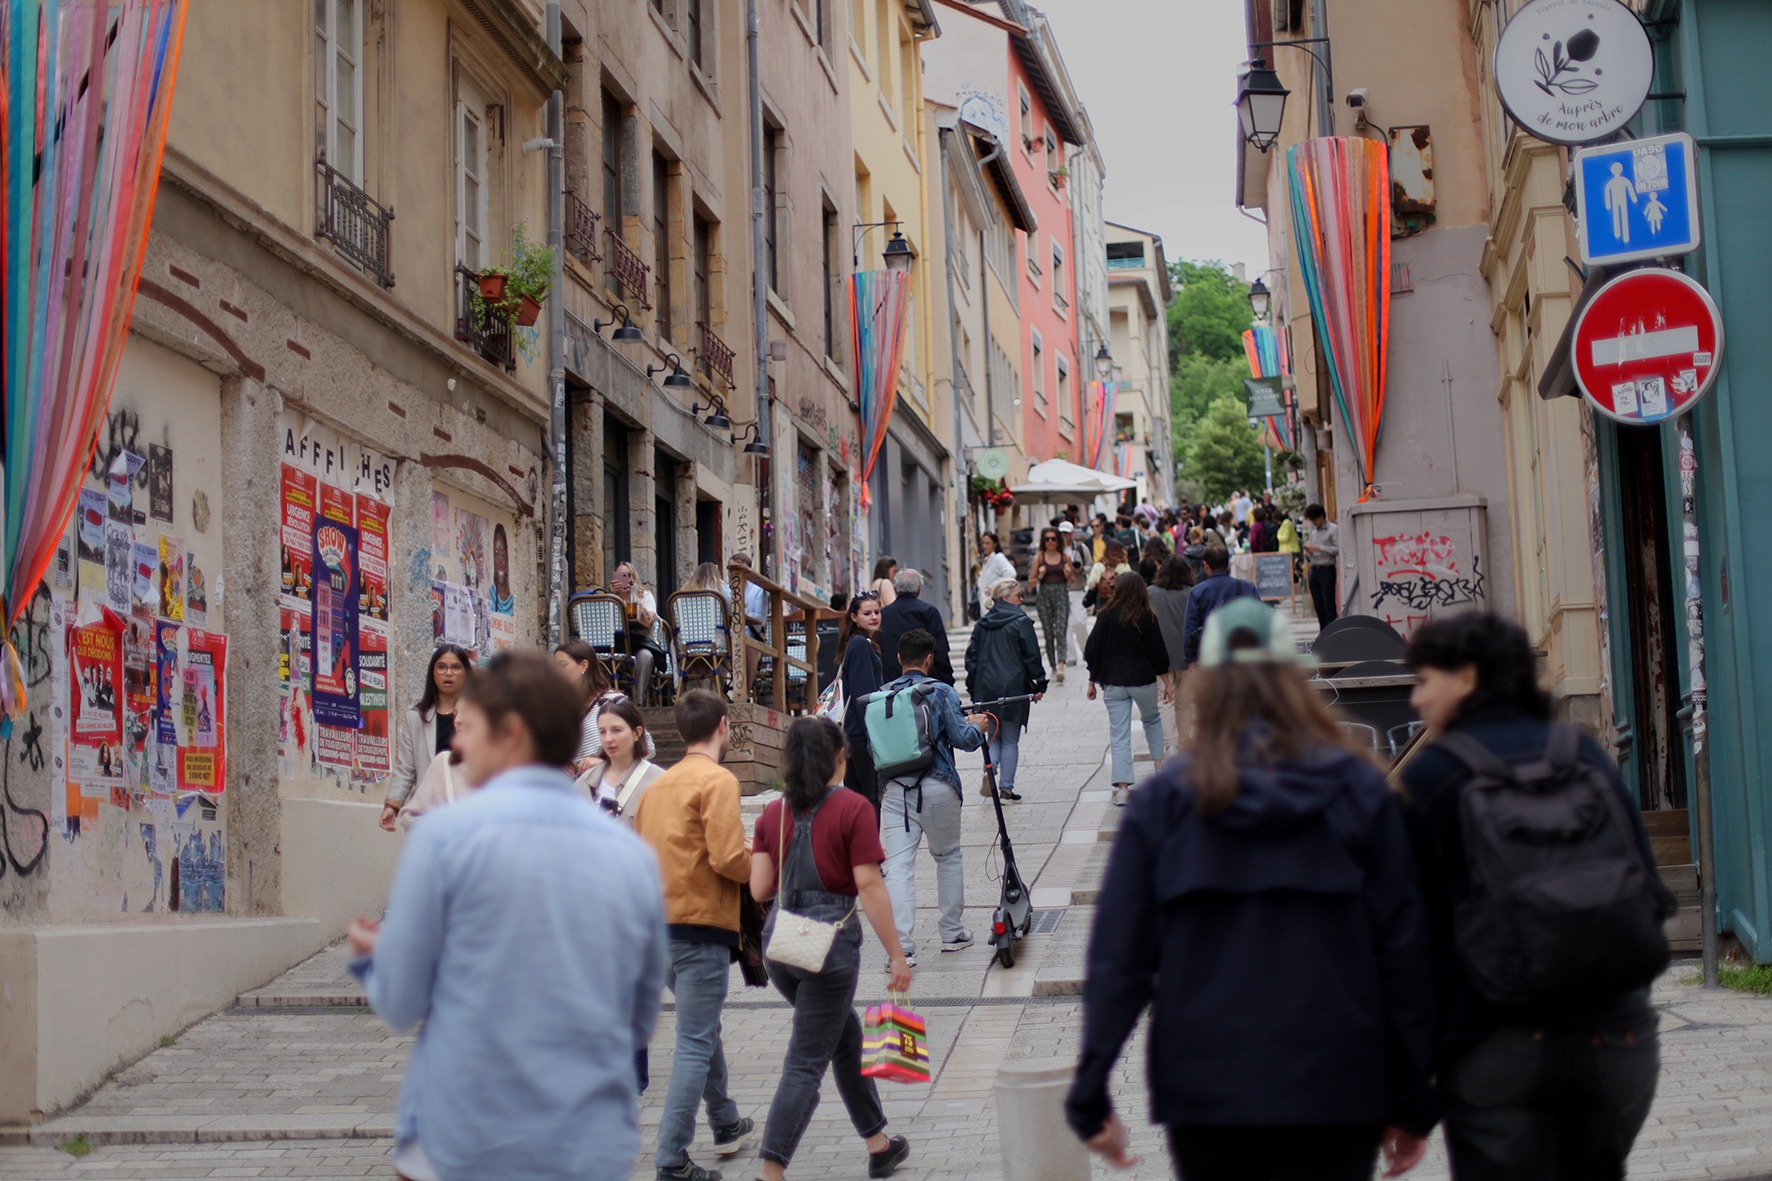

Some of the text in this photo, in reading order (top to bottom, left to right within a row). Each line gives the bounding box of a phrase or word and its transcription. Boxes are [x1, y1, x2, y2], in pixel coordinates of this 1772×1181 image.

[1536, 104, 1624, 131] de mon arbre
[1558, 99, 1603, 118] Auprès
[1632, 144, 1663, 157] UA90
[1636, 177, 1668, 191] ON TOUR
[285, 428, 390, 493] AFFFIHES
[286, 502, 311, 523] URGENCE
[319, 527, 345, 553] SHOW
[77, 630, 115, 651] C'EST NOUS
[359, 653, 386, 667] SOLIDARITÉ
[319, 726, 352, 742] TRAVAILLEURS
[903, 1034, 914, 1047] 75
